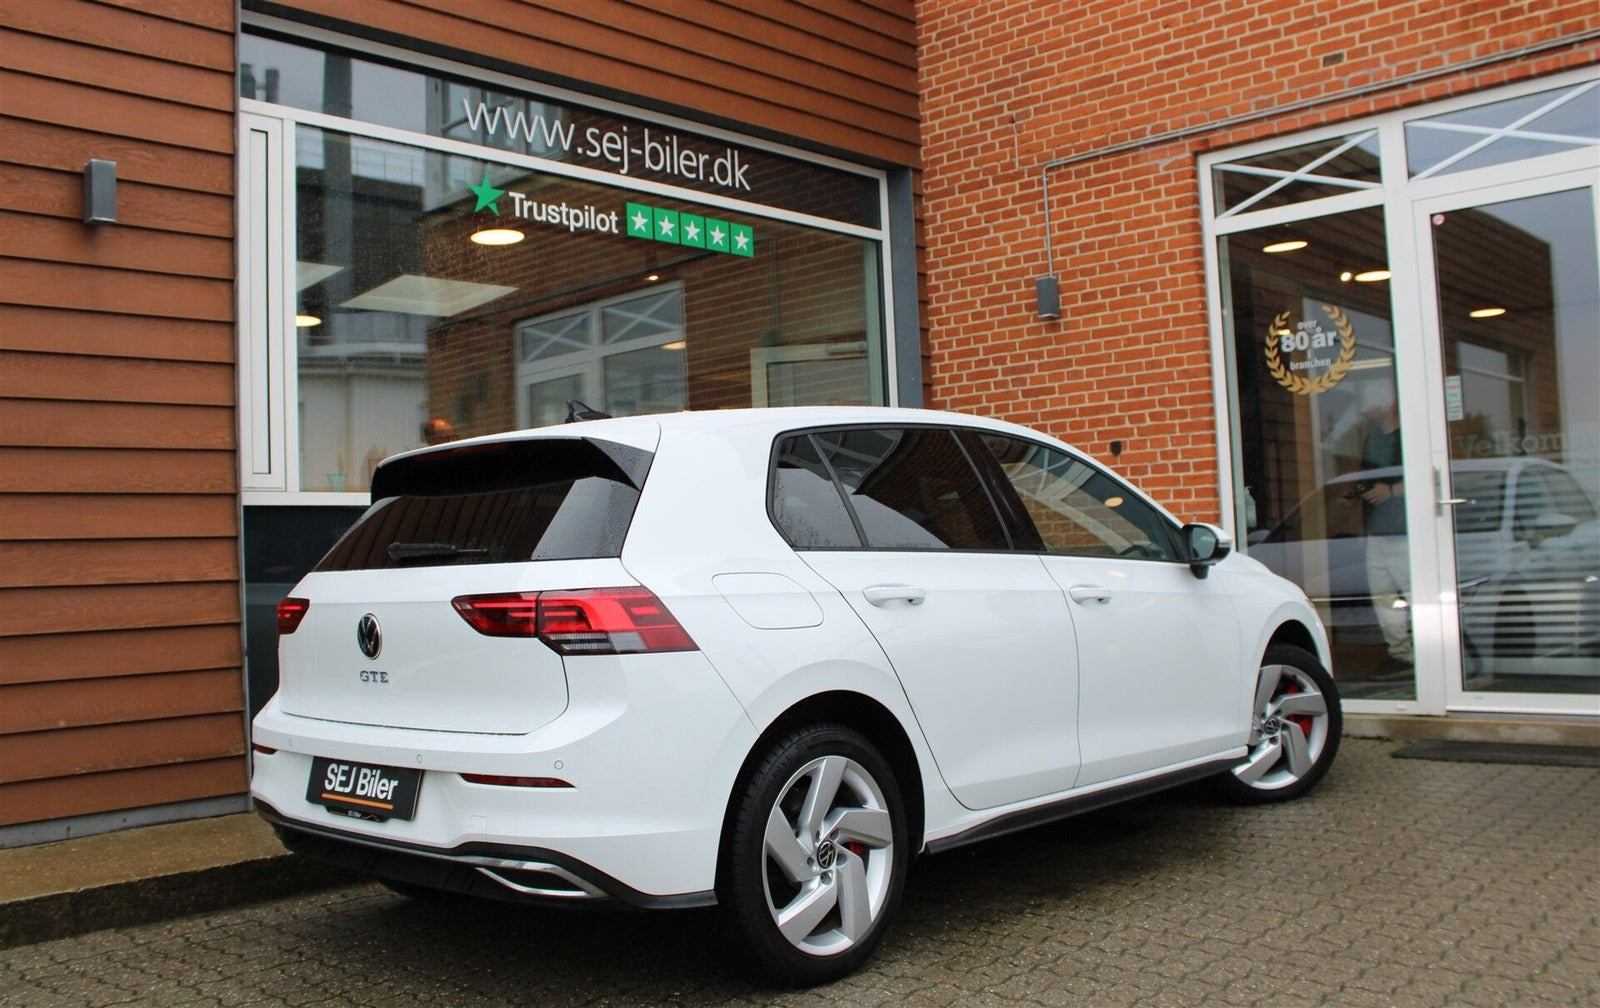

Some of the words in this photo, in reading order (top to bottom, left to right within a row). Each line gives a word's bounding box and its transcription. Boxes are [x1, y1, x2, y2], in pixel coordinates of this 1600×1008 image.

[463, 98, 751, 191] www.sej-biler.dk
[508, 191, 618, 234] Trustpilot
[1281, 331, 1309, 353] 80
[1312, 326, 1337, 349] år
[1297, 320, 1317, 330] over
[359, 670, 389, 683] GTE
[325, 763, 356, 793] SEJ
[356, 767, 398, 800] Biler
